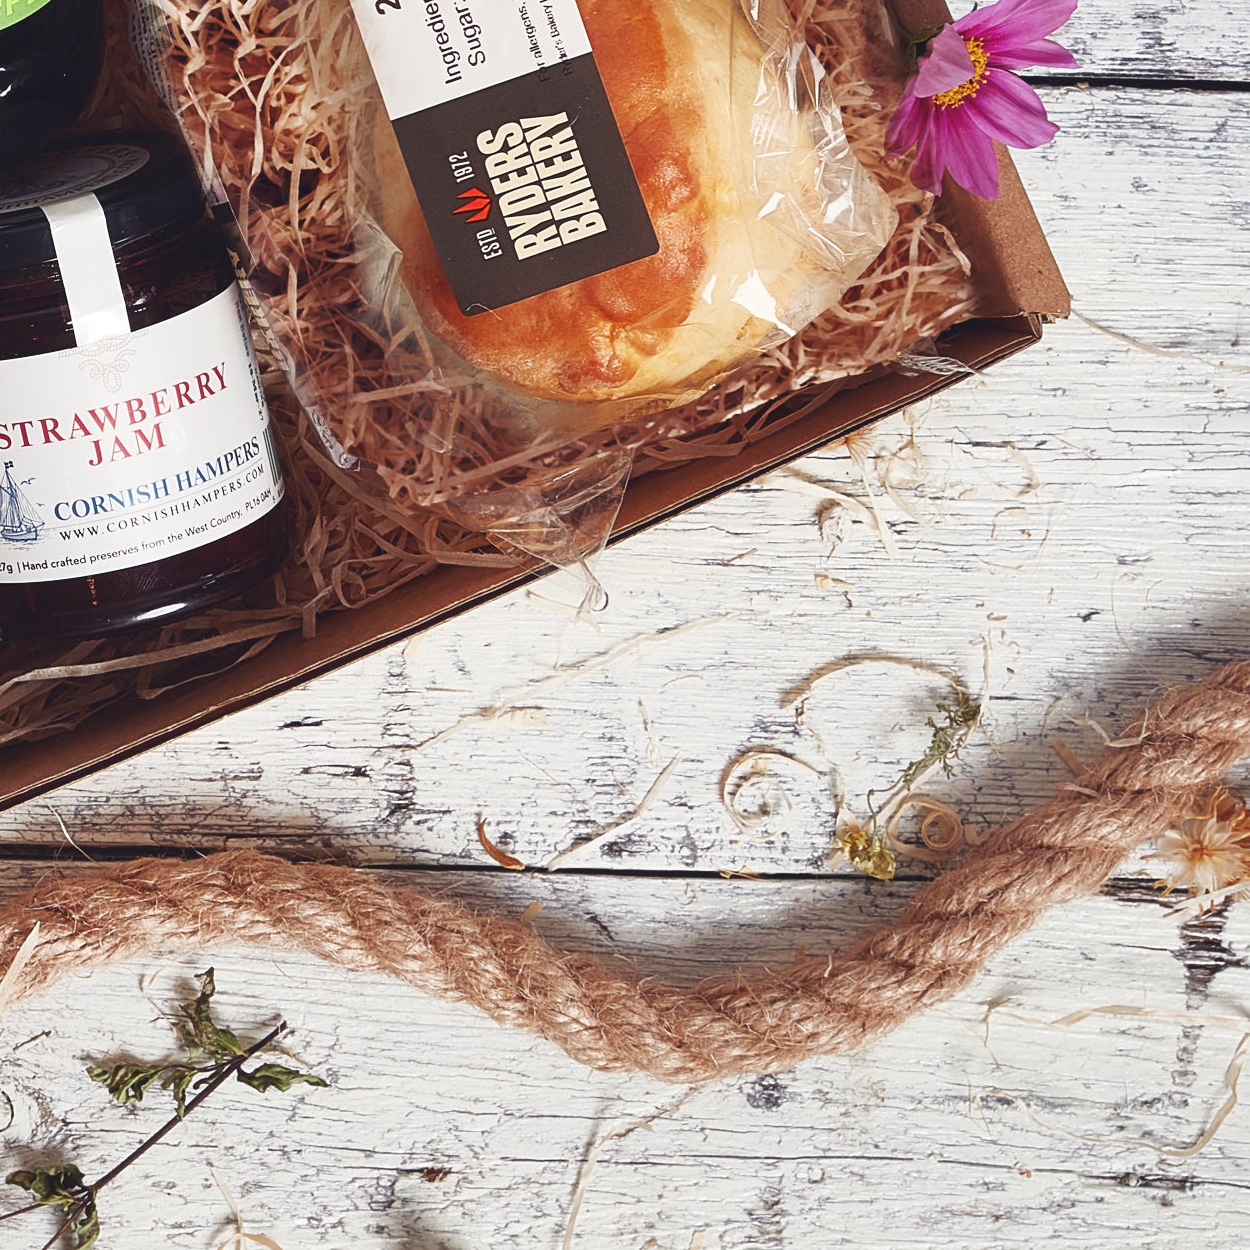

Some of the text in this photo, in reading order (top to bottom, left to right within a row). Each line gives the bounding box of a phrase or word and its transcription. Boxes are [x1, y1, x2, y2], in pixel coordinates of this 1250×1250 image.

[544, 4, 560, 38] Bakery
[449, 151, 502, 260] ESTD 1972
[476, 122, 562, 260] RYDERS
[519, 111, 607, 245] BAKERY
[54, 436, 261, 521] CORNISH HAMPERS
[88, 422, 167, 467] JAM
[22, 560, 48, 572] Hand
[50, 555, 87, 570] crafted
[89, 546, 139, 565] preserves
[141, 538, 166, 551] from
[167, 531, 183, 543] the
[184, 523, 209, 538] West
[210, 510, 243, 530] Country,
[245, 497, 260, 511] PL16
[59, 463, 265, 541] WWW.CORNISHHAMPERS.COM
